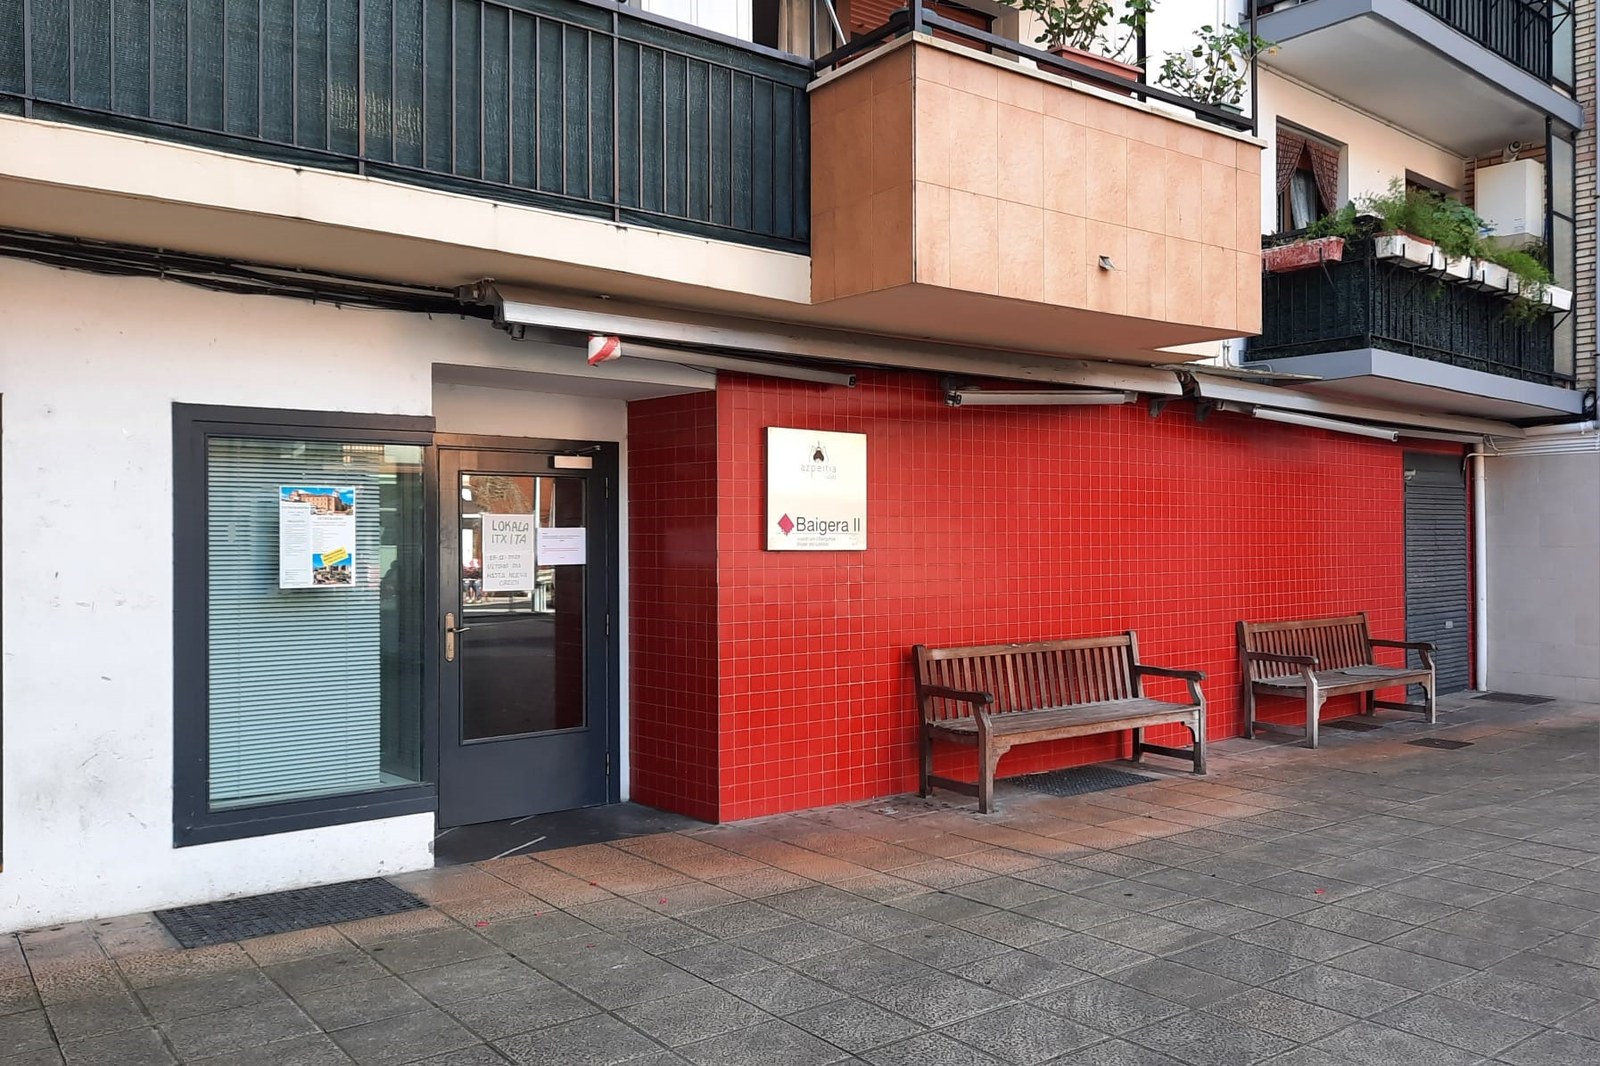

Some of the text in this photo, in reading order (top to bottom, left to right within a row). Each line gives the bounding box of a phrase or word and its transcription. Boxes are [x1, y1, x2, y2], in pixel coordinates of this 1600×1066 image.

[492, 520, 529, 532] LOKALA
[796, 517, 861, 536] Baigera II
